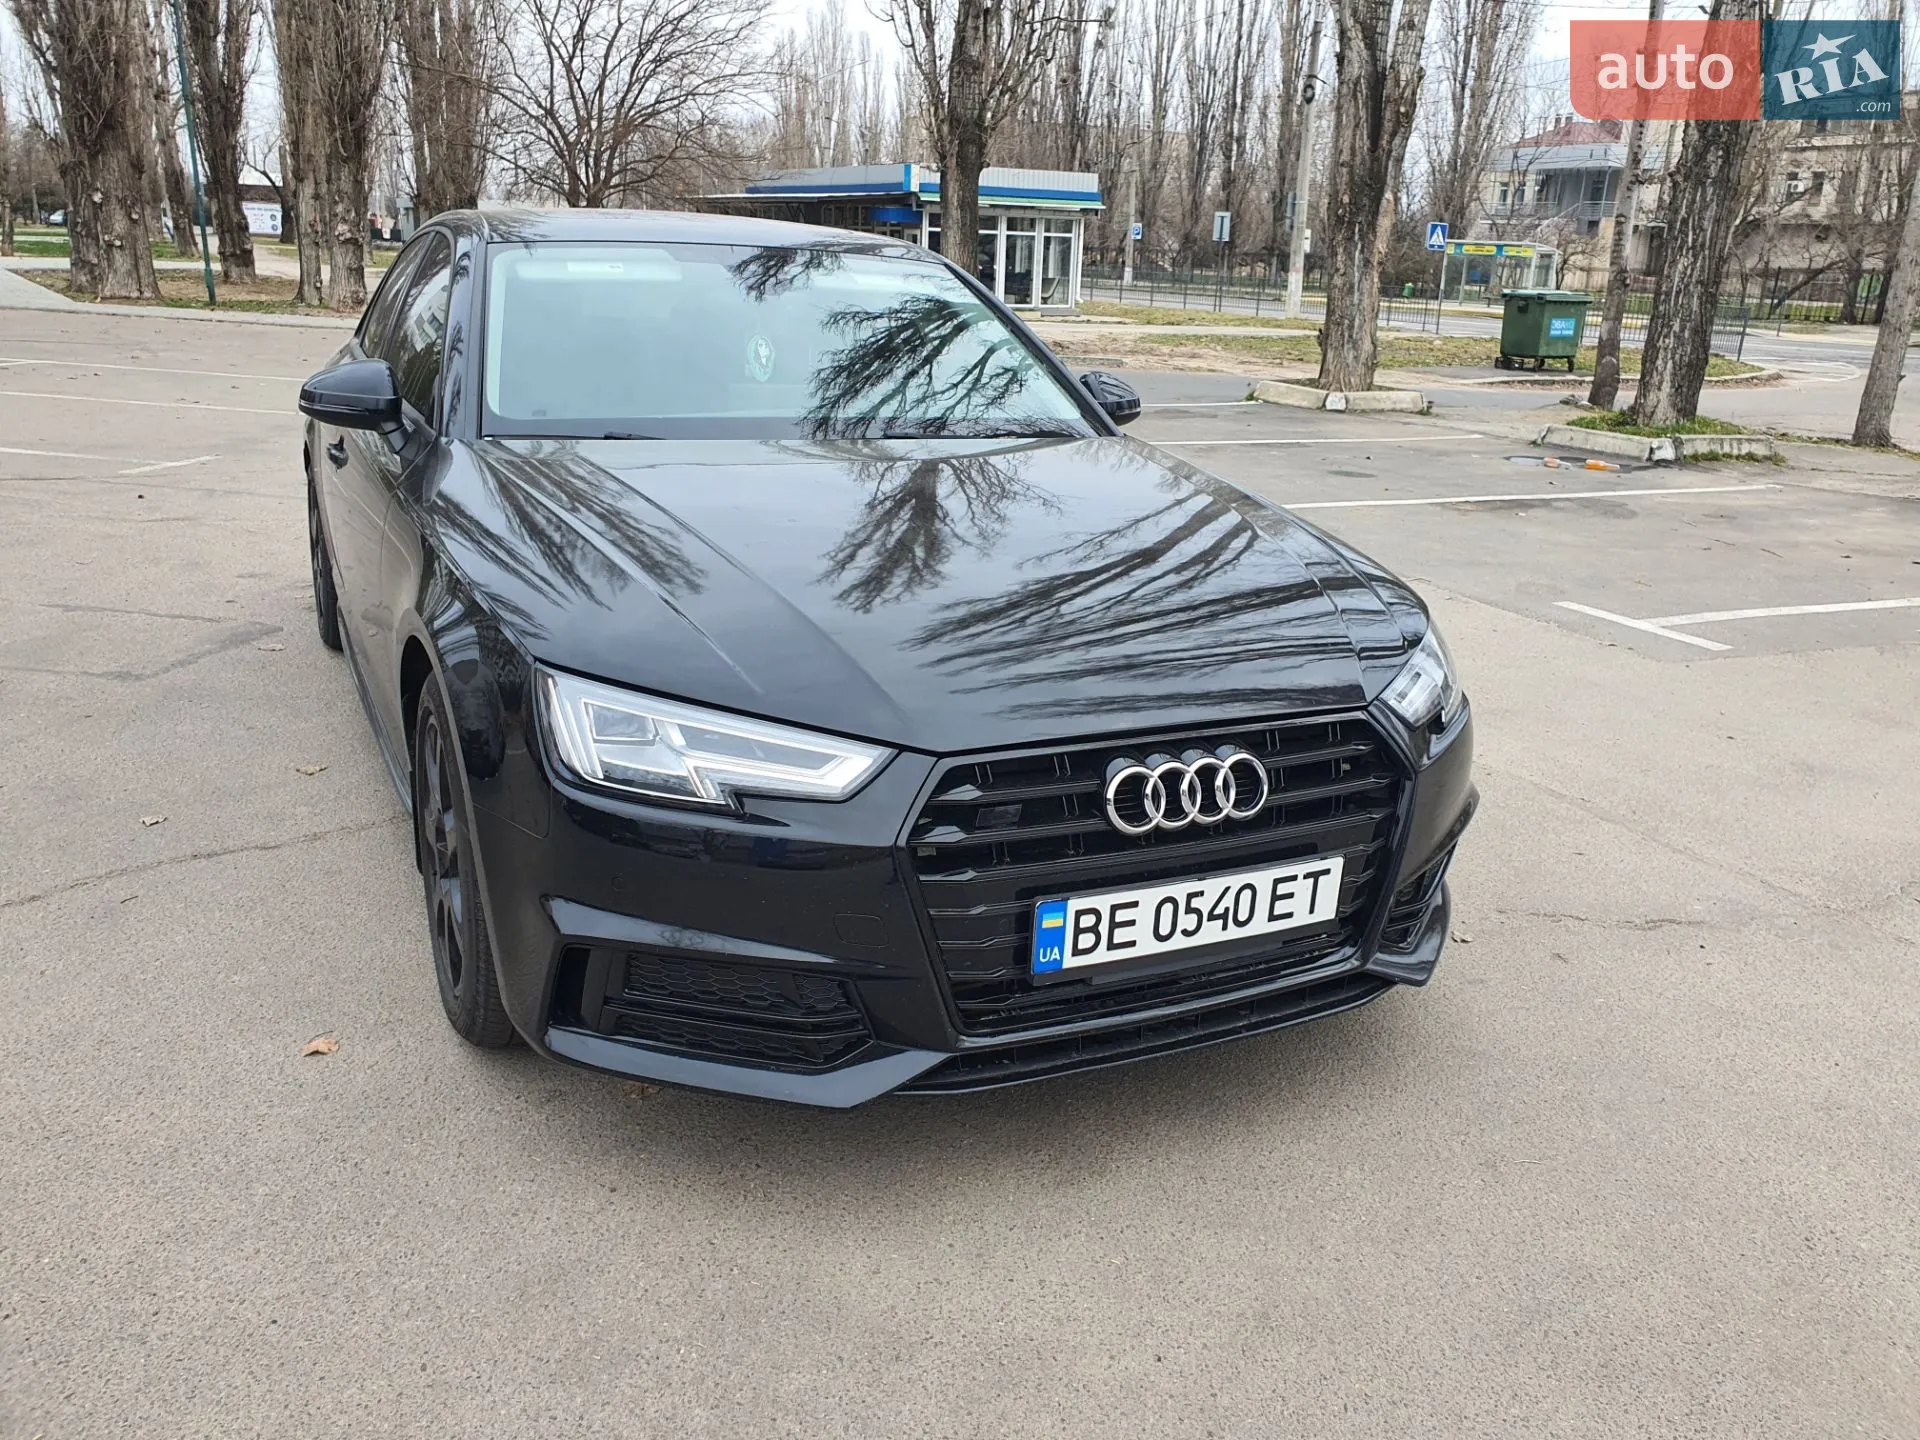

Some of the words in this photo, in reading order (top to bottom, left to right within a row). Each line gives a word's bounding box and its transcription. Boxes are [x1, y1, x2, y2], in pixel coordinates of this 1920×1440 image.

[1070, 899, 1140, 958] BE
[1152, 882, 1257, 943] 0540
[1267, 867, 1332, 923] ET
[1039, 945, 1061, 963] UA
